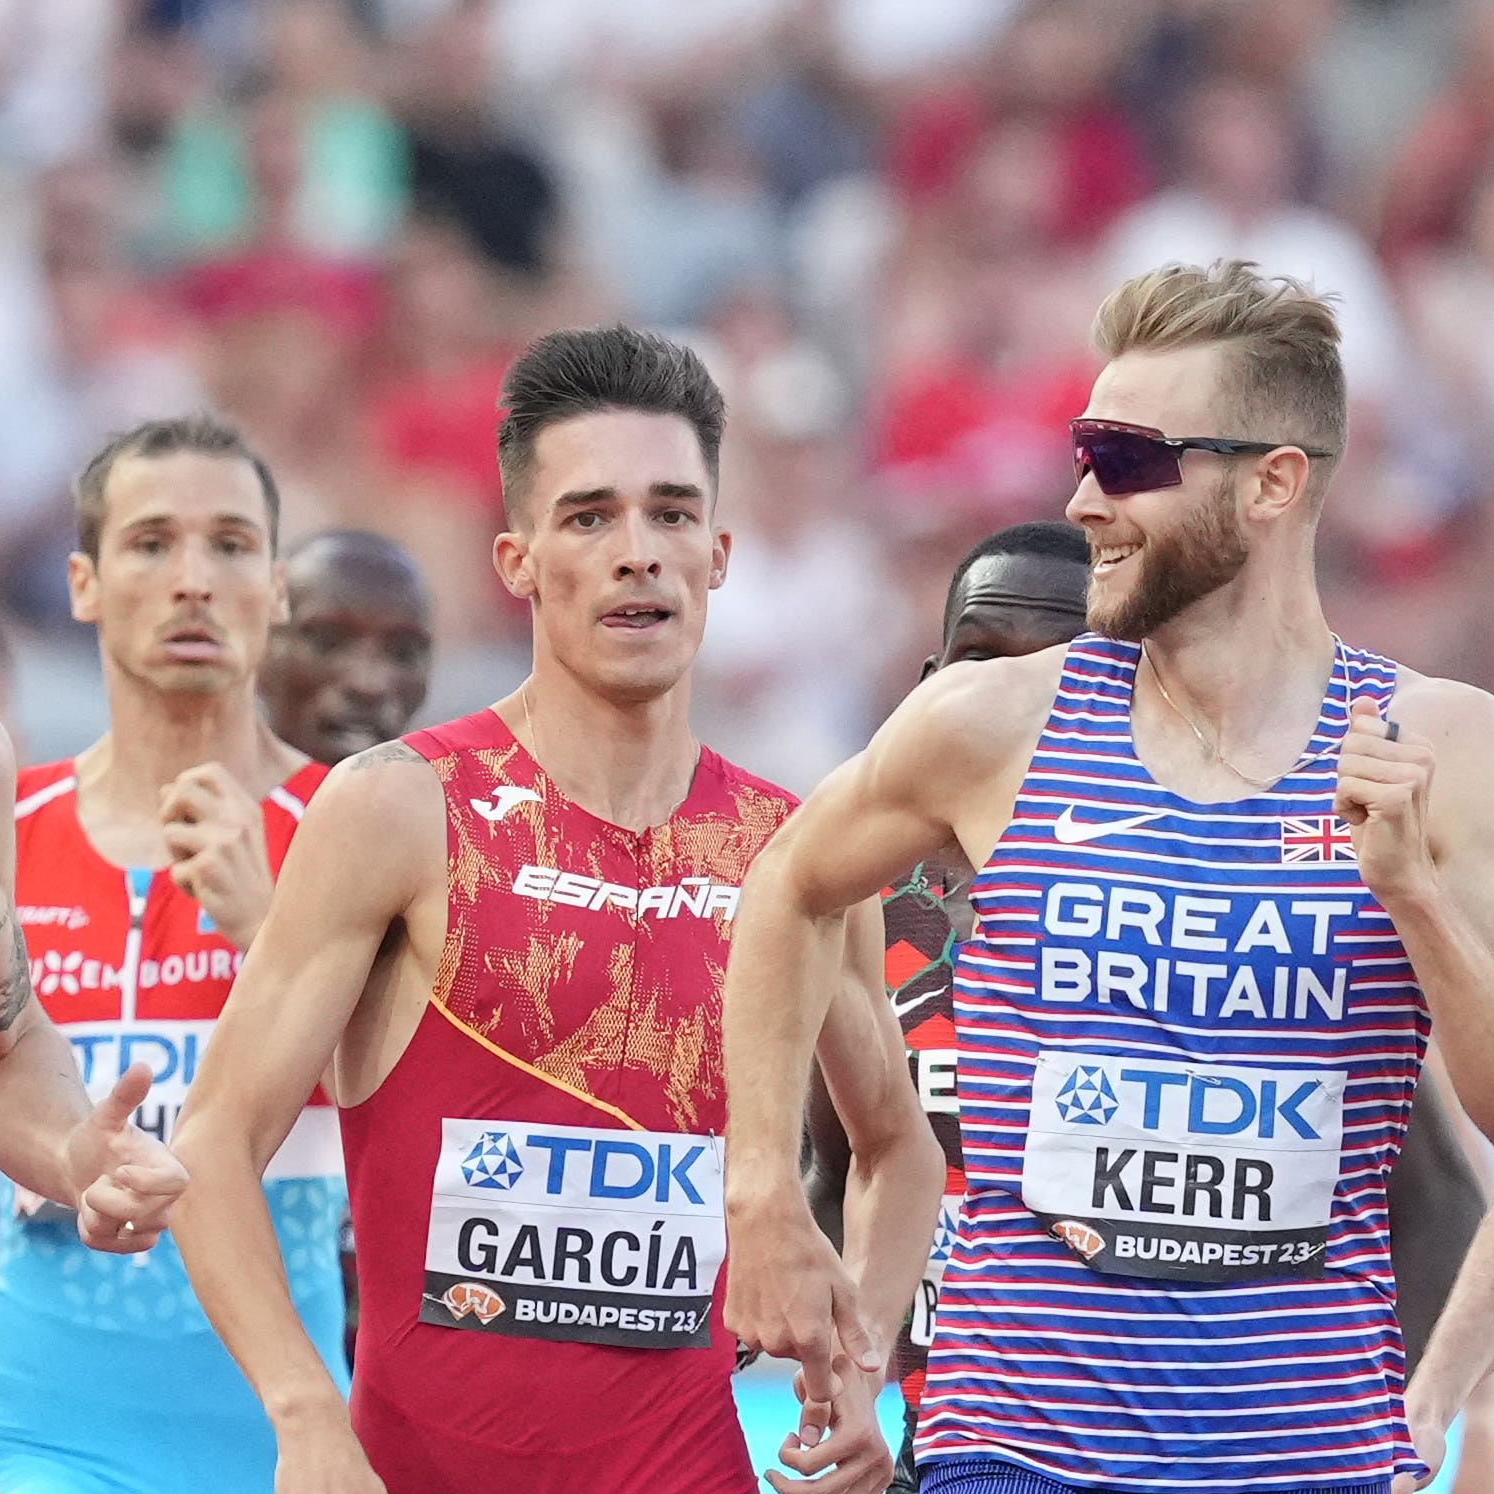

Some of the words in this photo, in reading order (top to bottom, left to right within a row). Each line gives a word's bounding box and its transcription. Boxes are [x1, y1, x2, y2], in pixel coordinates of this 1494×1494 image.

[511, 864, 742, 921] ESPAÑA
[1044, 883, 1353, 955] GREAT
[1041, 948, 1348, 1020] BRITAIN
[1119, 1068, 1323, 1140] TDK
[526, 1134, 707, 1204] TDK
[1091, 1147, 1275, 1223] KERR
[457, 1217, 698, 1290] GARCÍA
[1115, 1235, 1277, 1266] BUDAPEST
[1278, 1242, 1310, 1264] 23
[515, 1299, 670, 1332] BUDAPEST
[672, 1310, 697, 1333] 23
